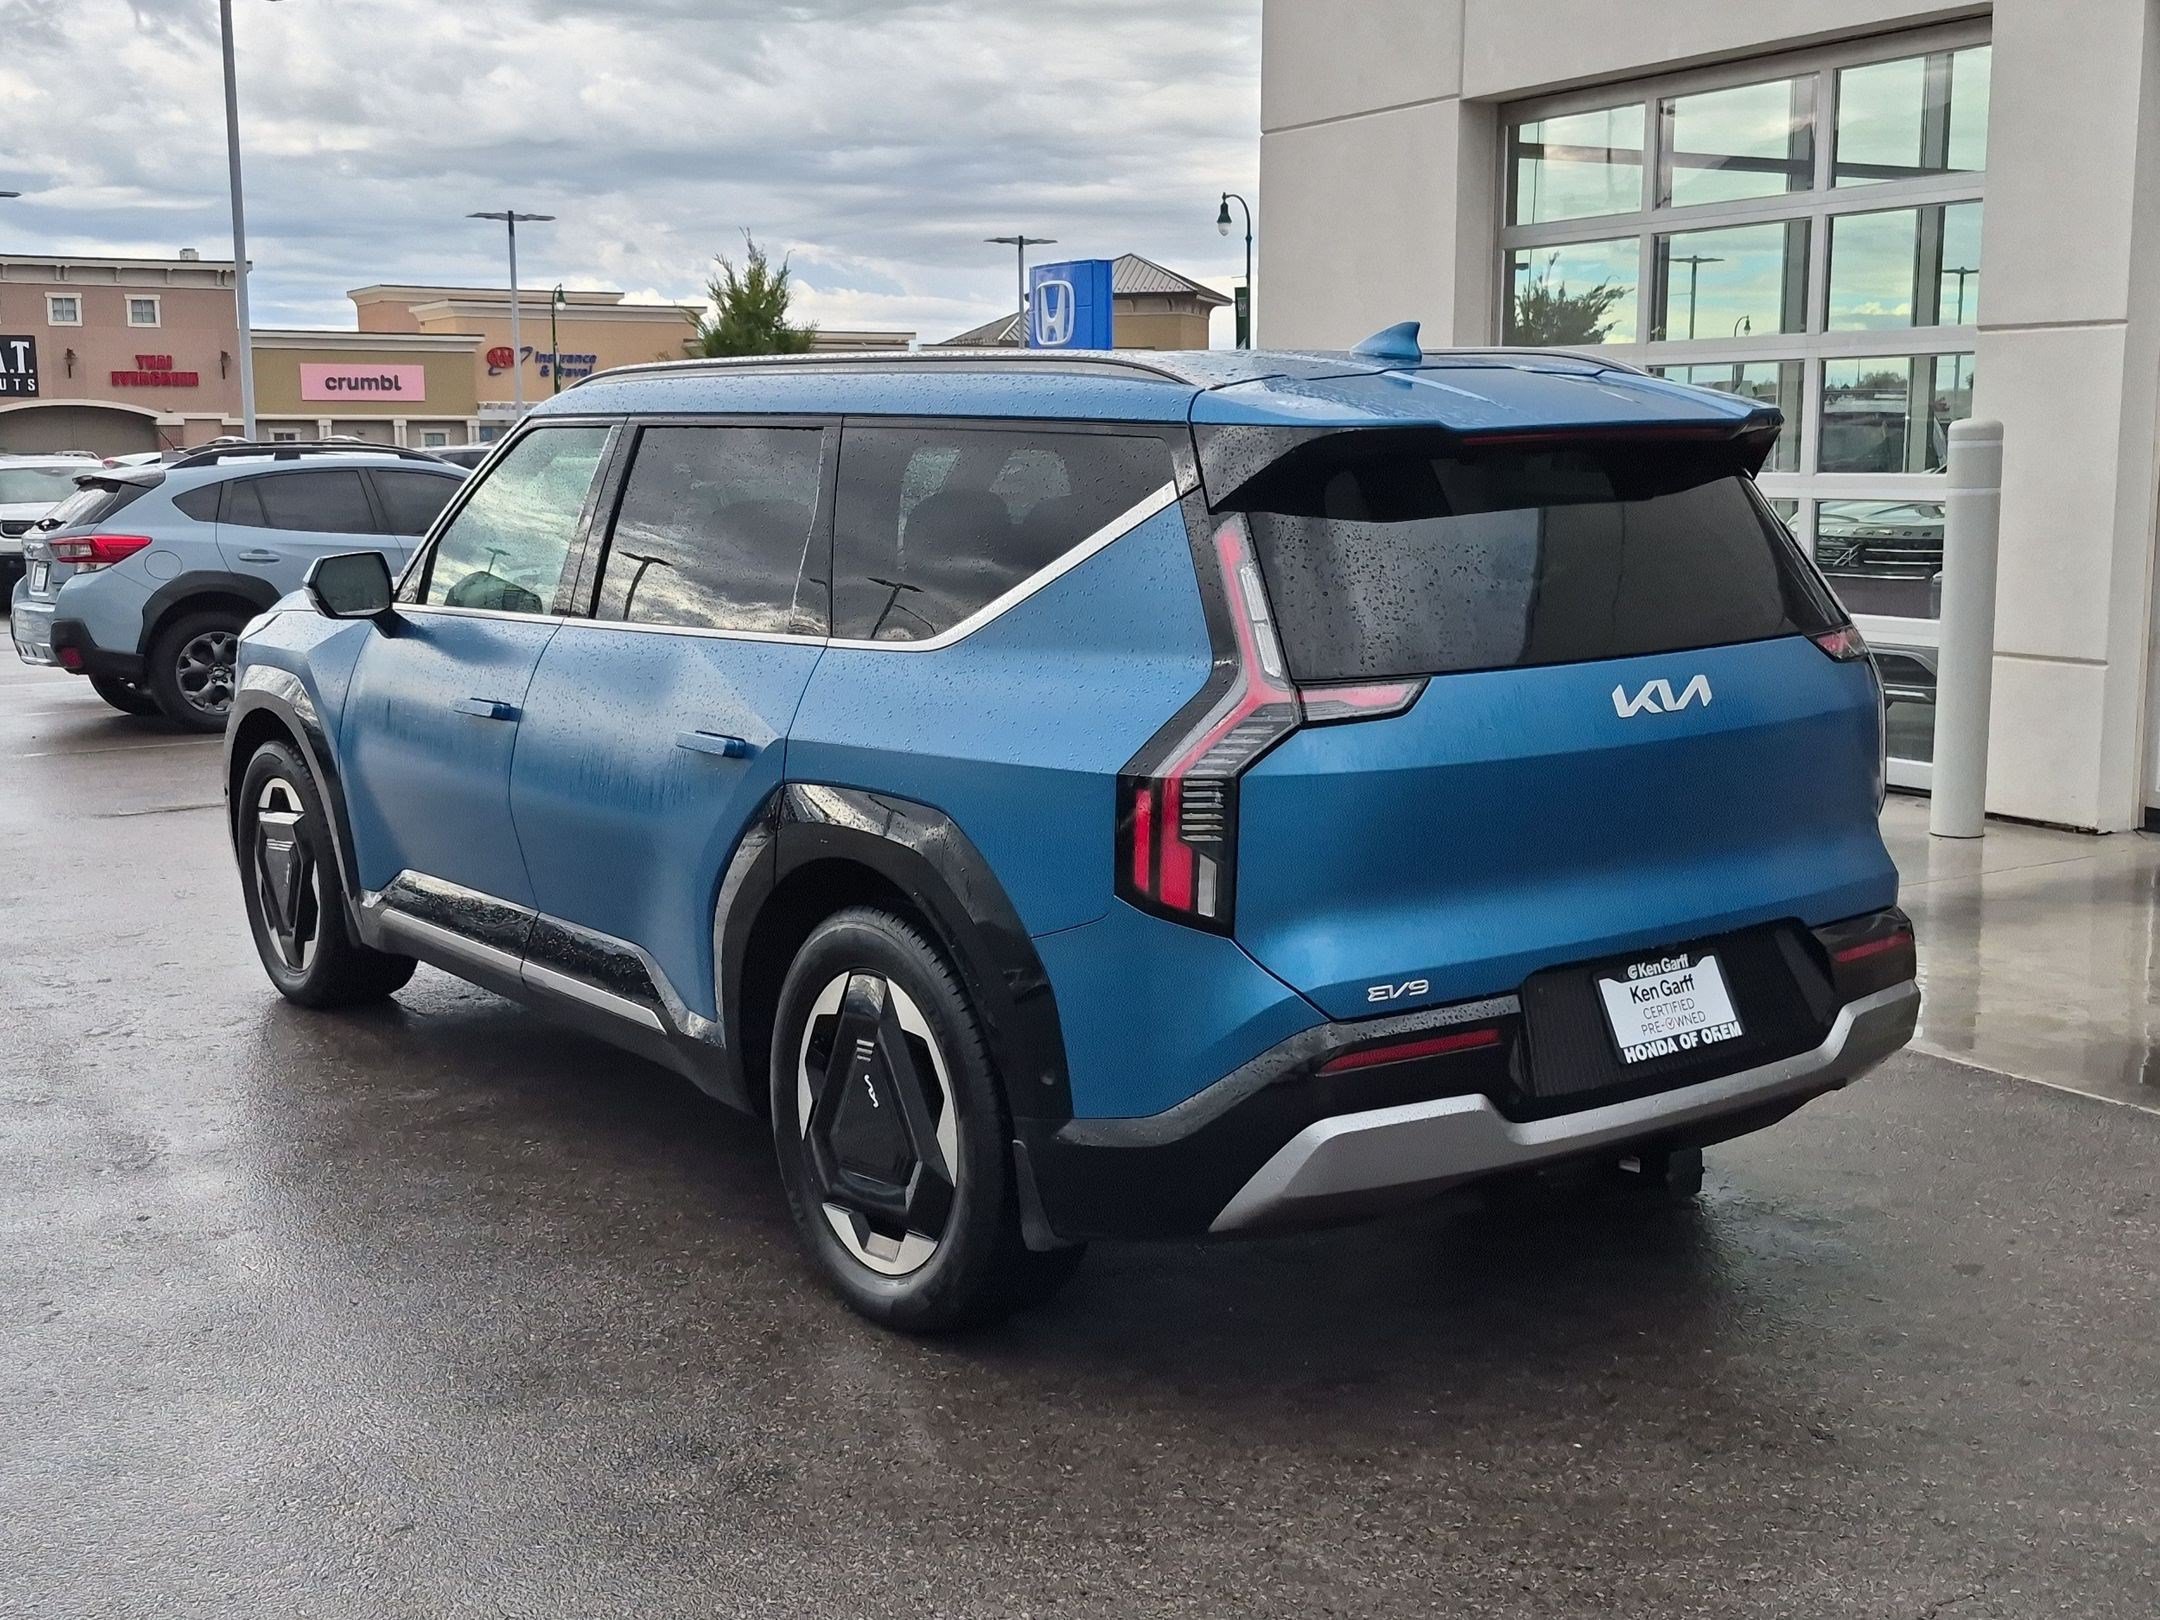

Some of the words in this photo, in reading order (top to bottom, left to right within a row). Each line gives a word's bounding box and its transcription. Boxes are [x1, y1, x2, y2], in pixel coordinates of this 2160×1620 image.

[535, 351, 597, 364] Insrance
[325, 374, 402, 391] crumbl
[556, 365, 593, 378] ravel
[1611, 674, 1713, 718] KIA
[1367, 979, 1429, 1002] EV9
[1629, 985, 1660, 1004] Ken
[1660, 973, 1695, 997] Garff
[1643, 997, 1695, 1020] CERTIFIED
[1623, 1037, 1679, 1064] HONDA
[1679, 1031, 1699, 1050] OF
[1701, 1021, 1743, 1044] OREM
